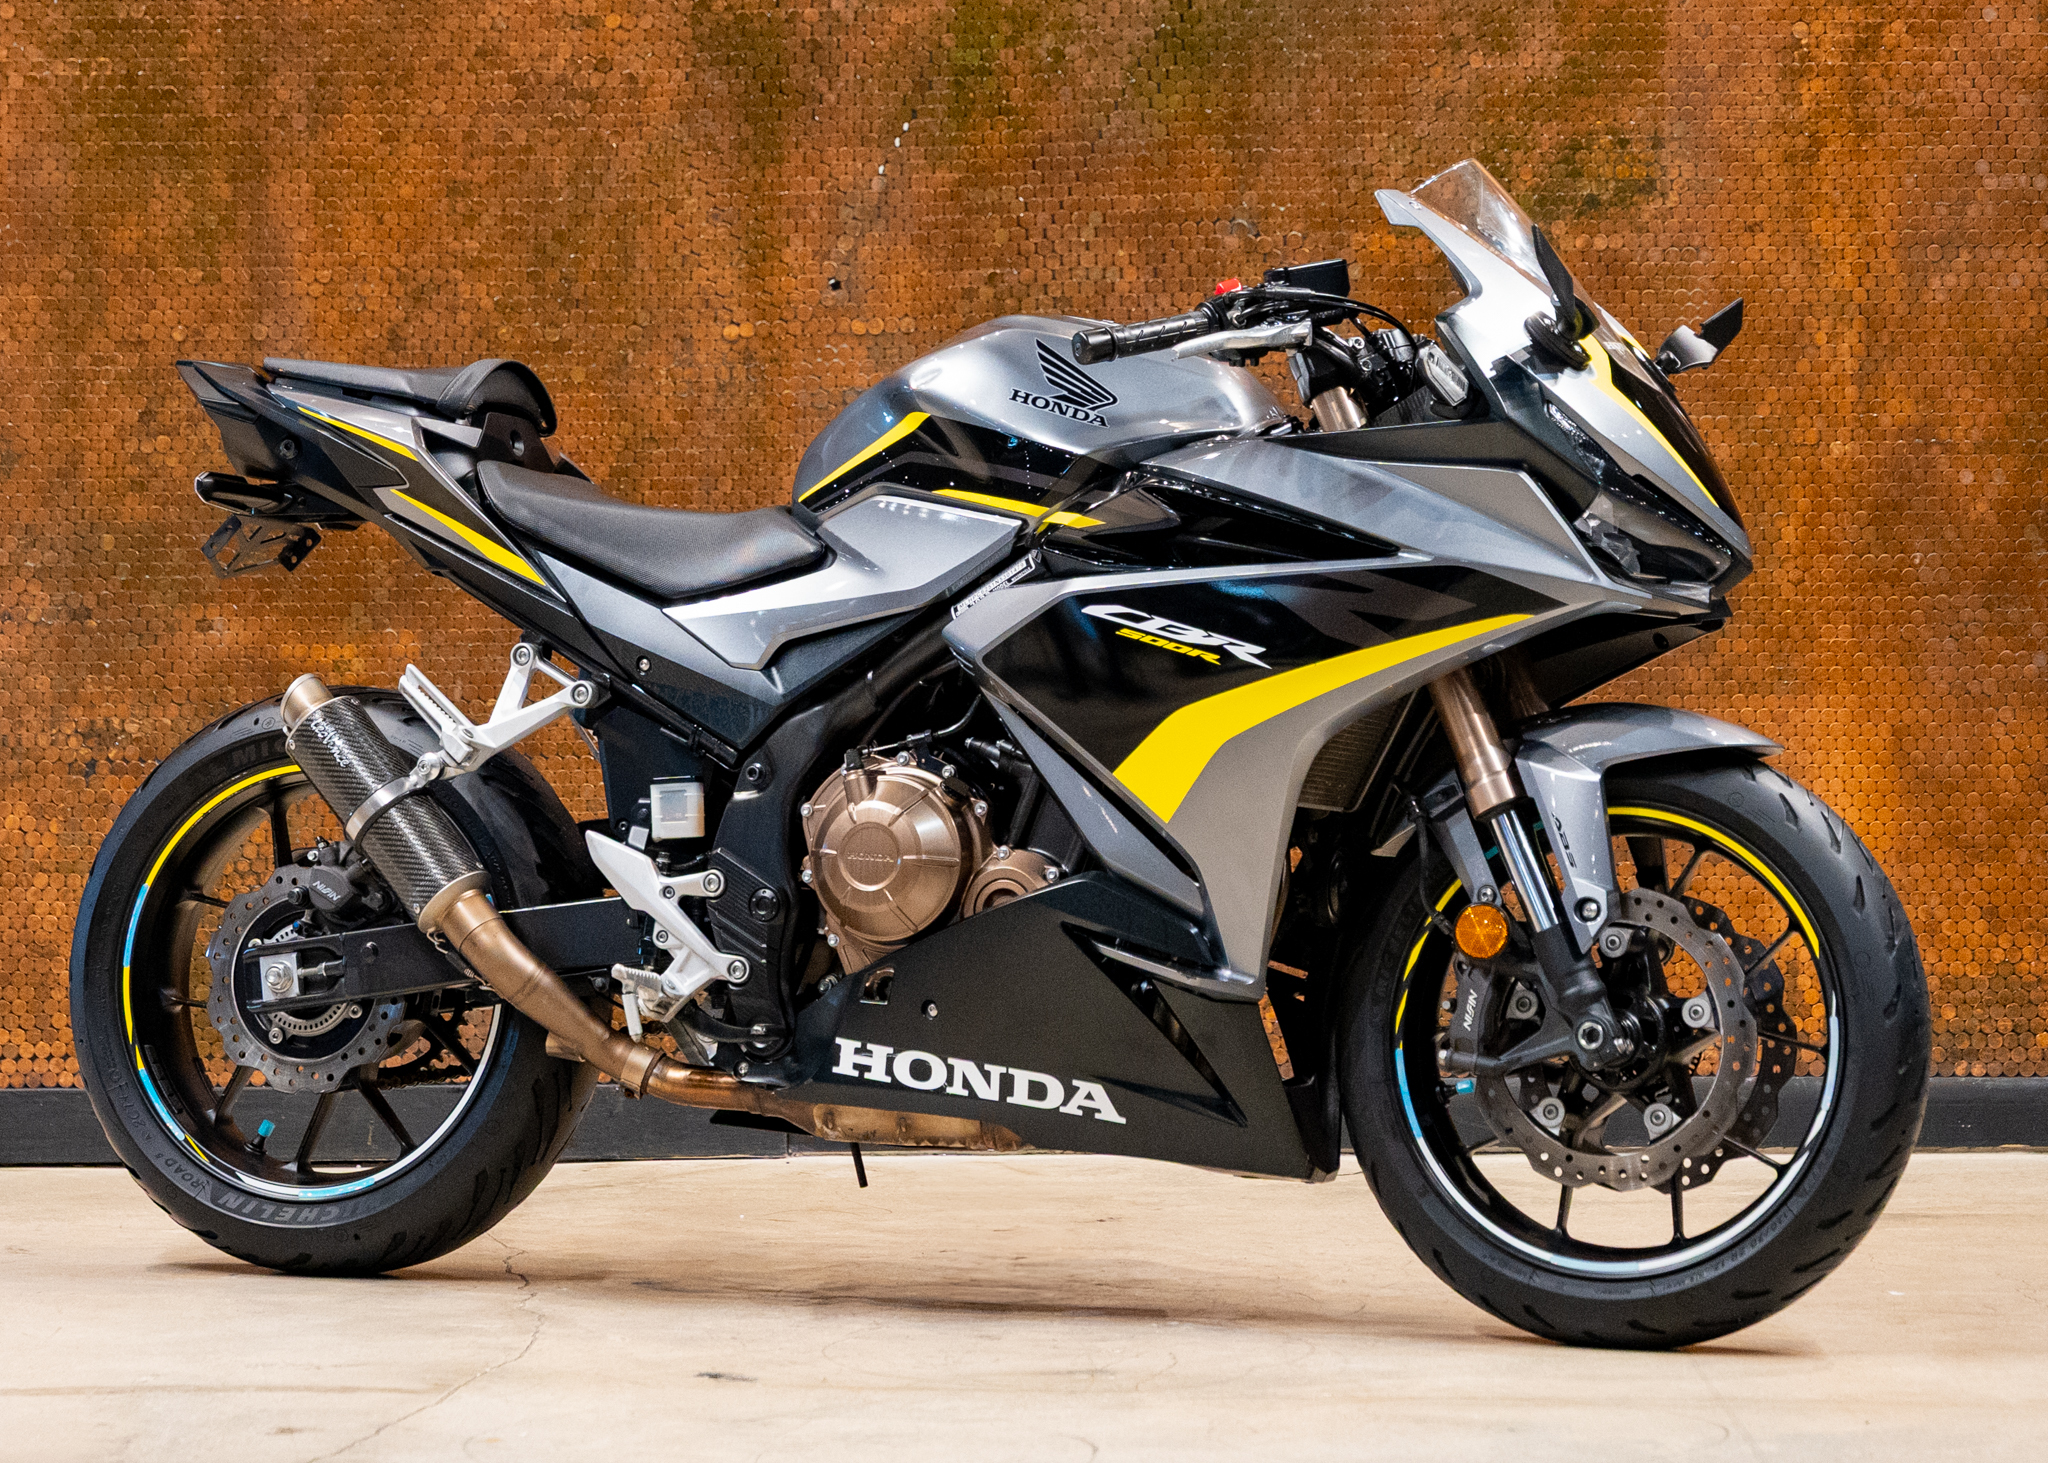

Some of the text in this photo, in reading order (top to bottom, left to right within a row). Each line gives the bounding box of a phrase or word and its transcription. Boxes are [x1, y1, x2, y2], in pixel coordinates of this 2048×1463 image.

[1009, 388, 1110, 428] HONDA
[1081, 604, 1272, 670] CBR
[1115, 628, 1221, 666] 500R
[846, 851, 895, 863] HONDA
[1551, 811, 1578, 869] ABS
[832, 1036, 1127, 1124] HONDA
